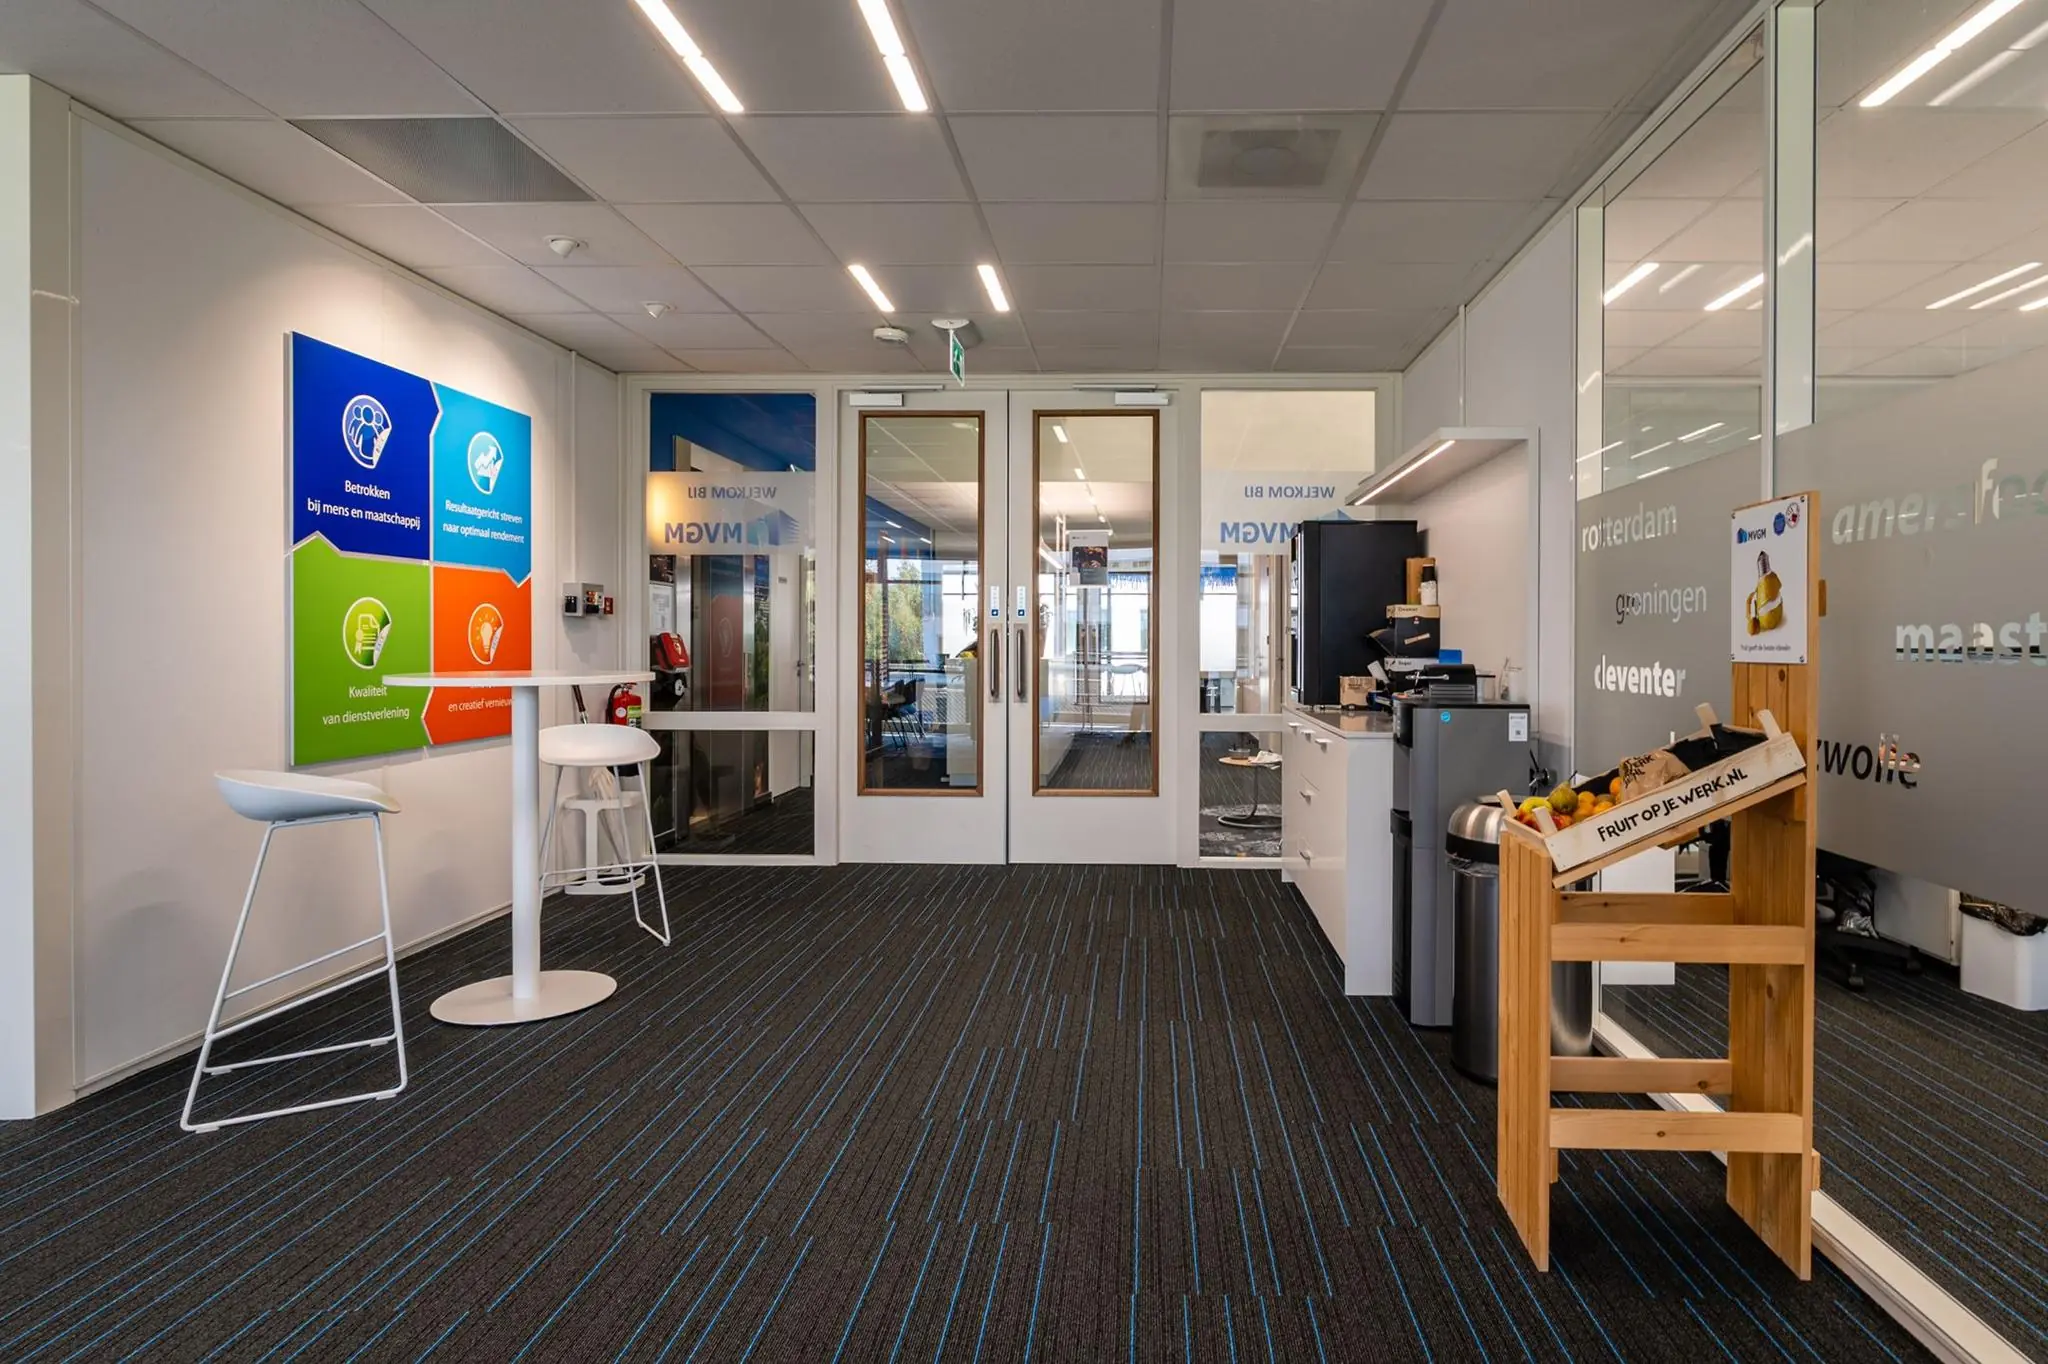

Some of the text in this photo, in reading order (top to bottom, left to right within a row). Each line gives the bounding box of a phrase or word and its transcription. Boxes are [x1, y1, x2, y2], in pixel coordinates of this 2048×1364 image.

[344, 479, 391, 500] Betrokken
[307, 497, 421, 531] bij mens en maatschappij
[445, 499, 523, 524] Resultaatgericht streven
[442, 522, 525, 544] naar optimaal rendement
[1582, 502, 1678, 552] rotterdam
[1616, 582, 1708, 625] groningen
[1895, 612, 2048, 666] maast
[1594, 655, 1687, 698] deventer
[348, 684, 388, 699] Kwaliteit
[322, 705, 410, 725] van dienstverlening
[448, 703, 458, 713] en
[458, 697, 484, 711] creatief
